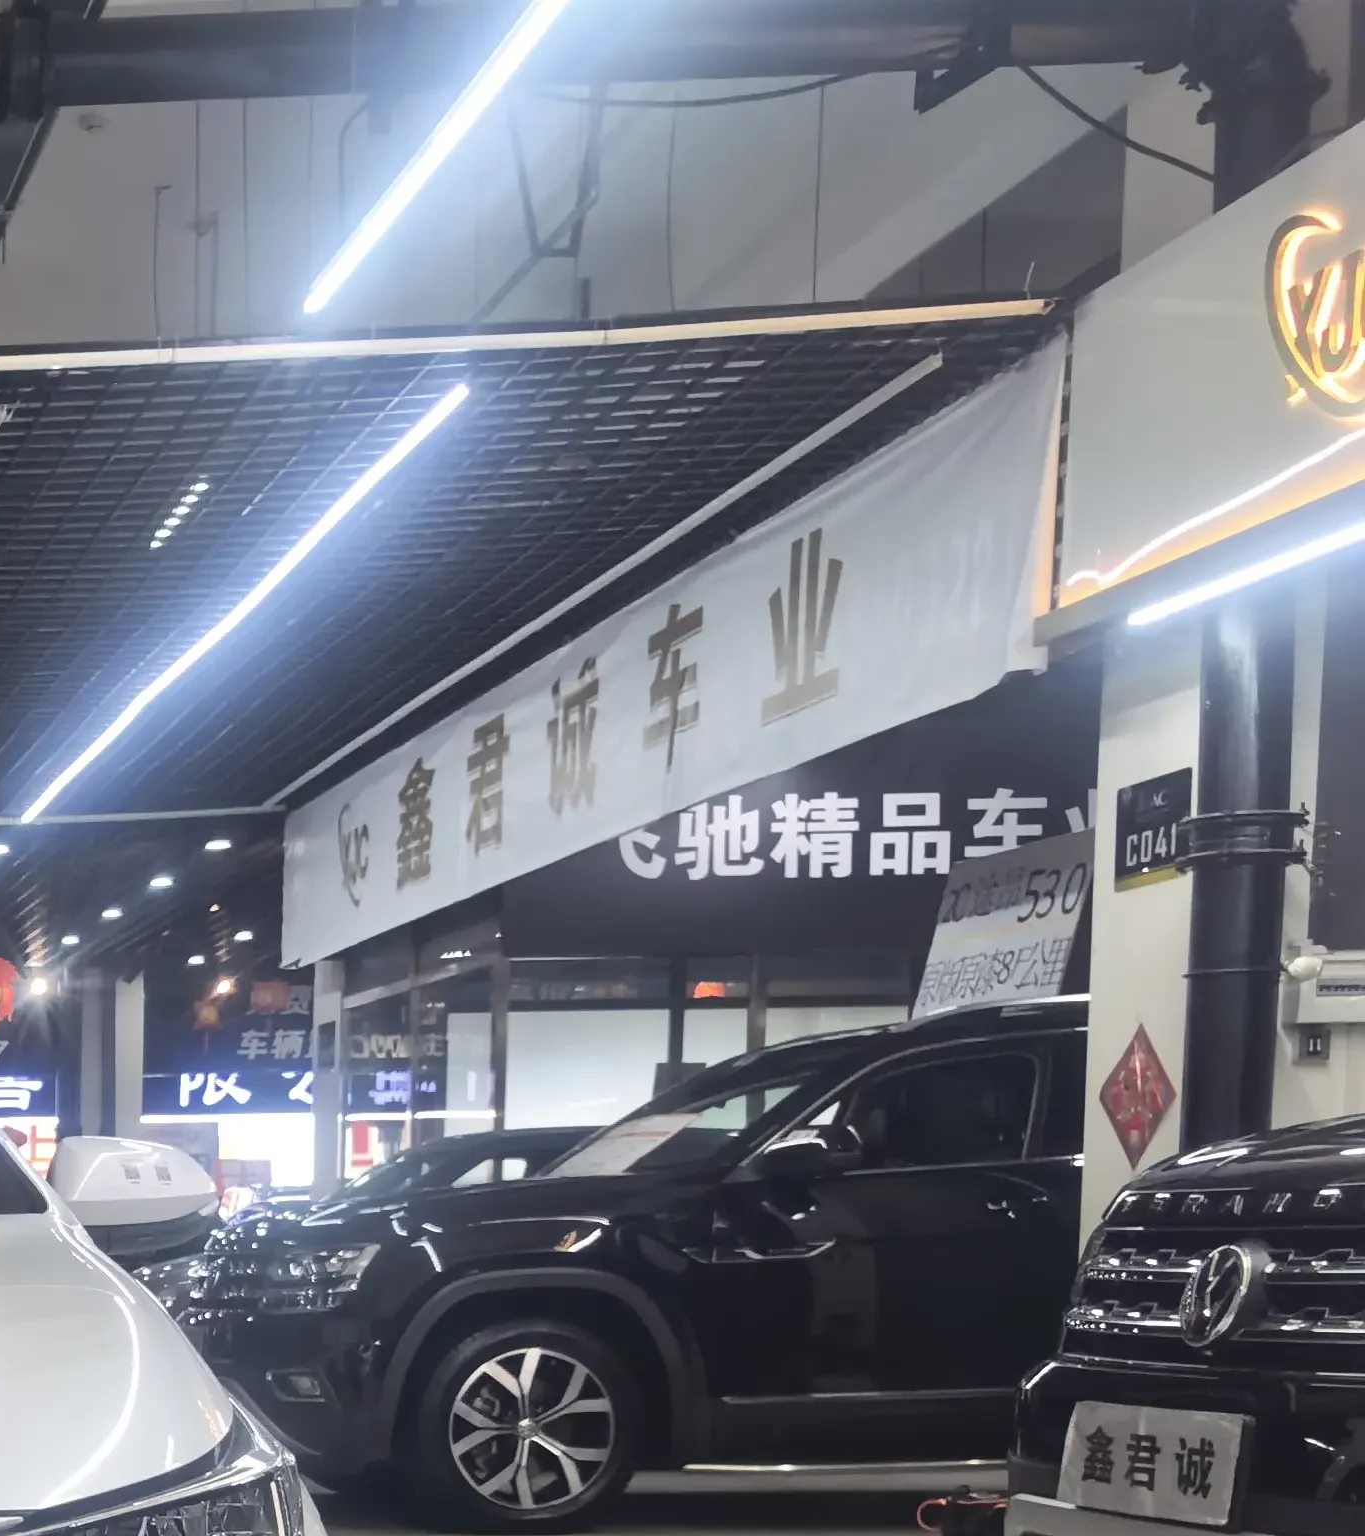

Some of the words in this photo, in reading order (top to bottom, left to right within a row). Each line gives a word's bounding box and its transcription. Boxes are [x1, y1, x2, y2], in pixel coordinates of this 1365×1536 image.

[396, 527, 843, 890] 鑫君诚车业
[619, 787, 1096, 881] 驰精品车
[1126, 822, 1177, 867] C041
[1081, 1425, 1216, 1500] 鑫君诚
